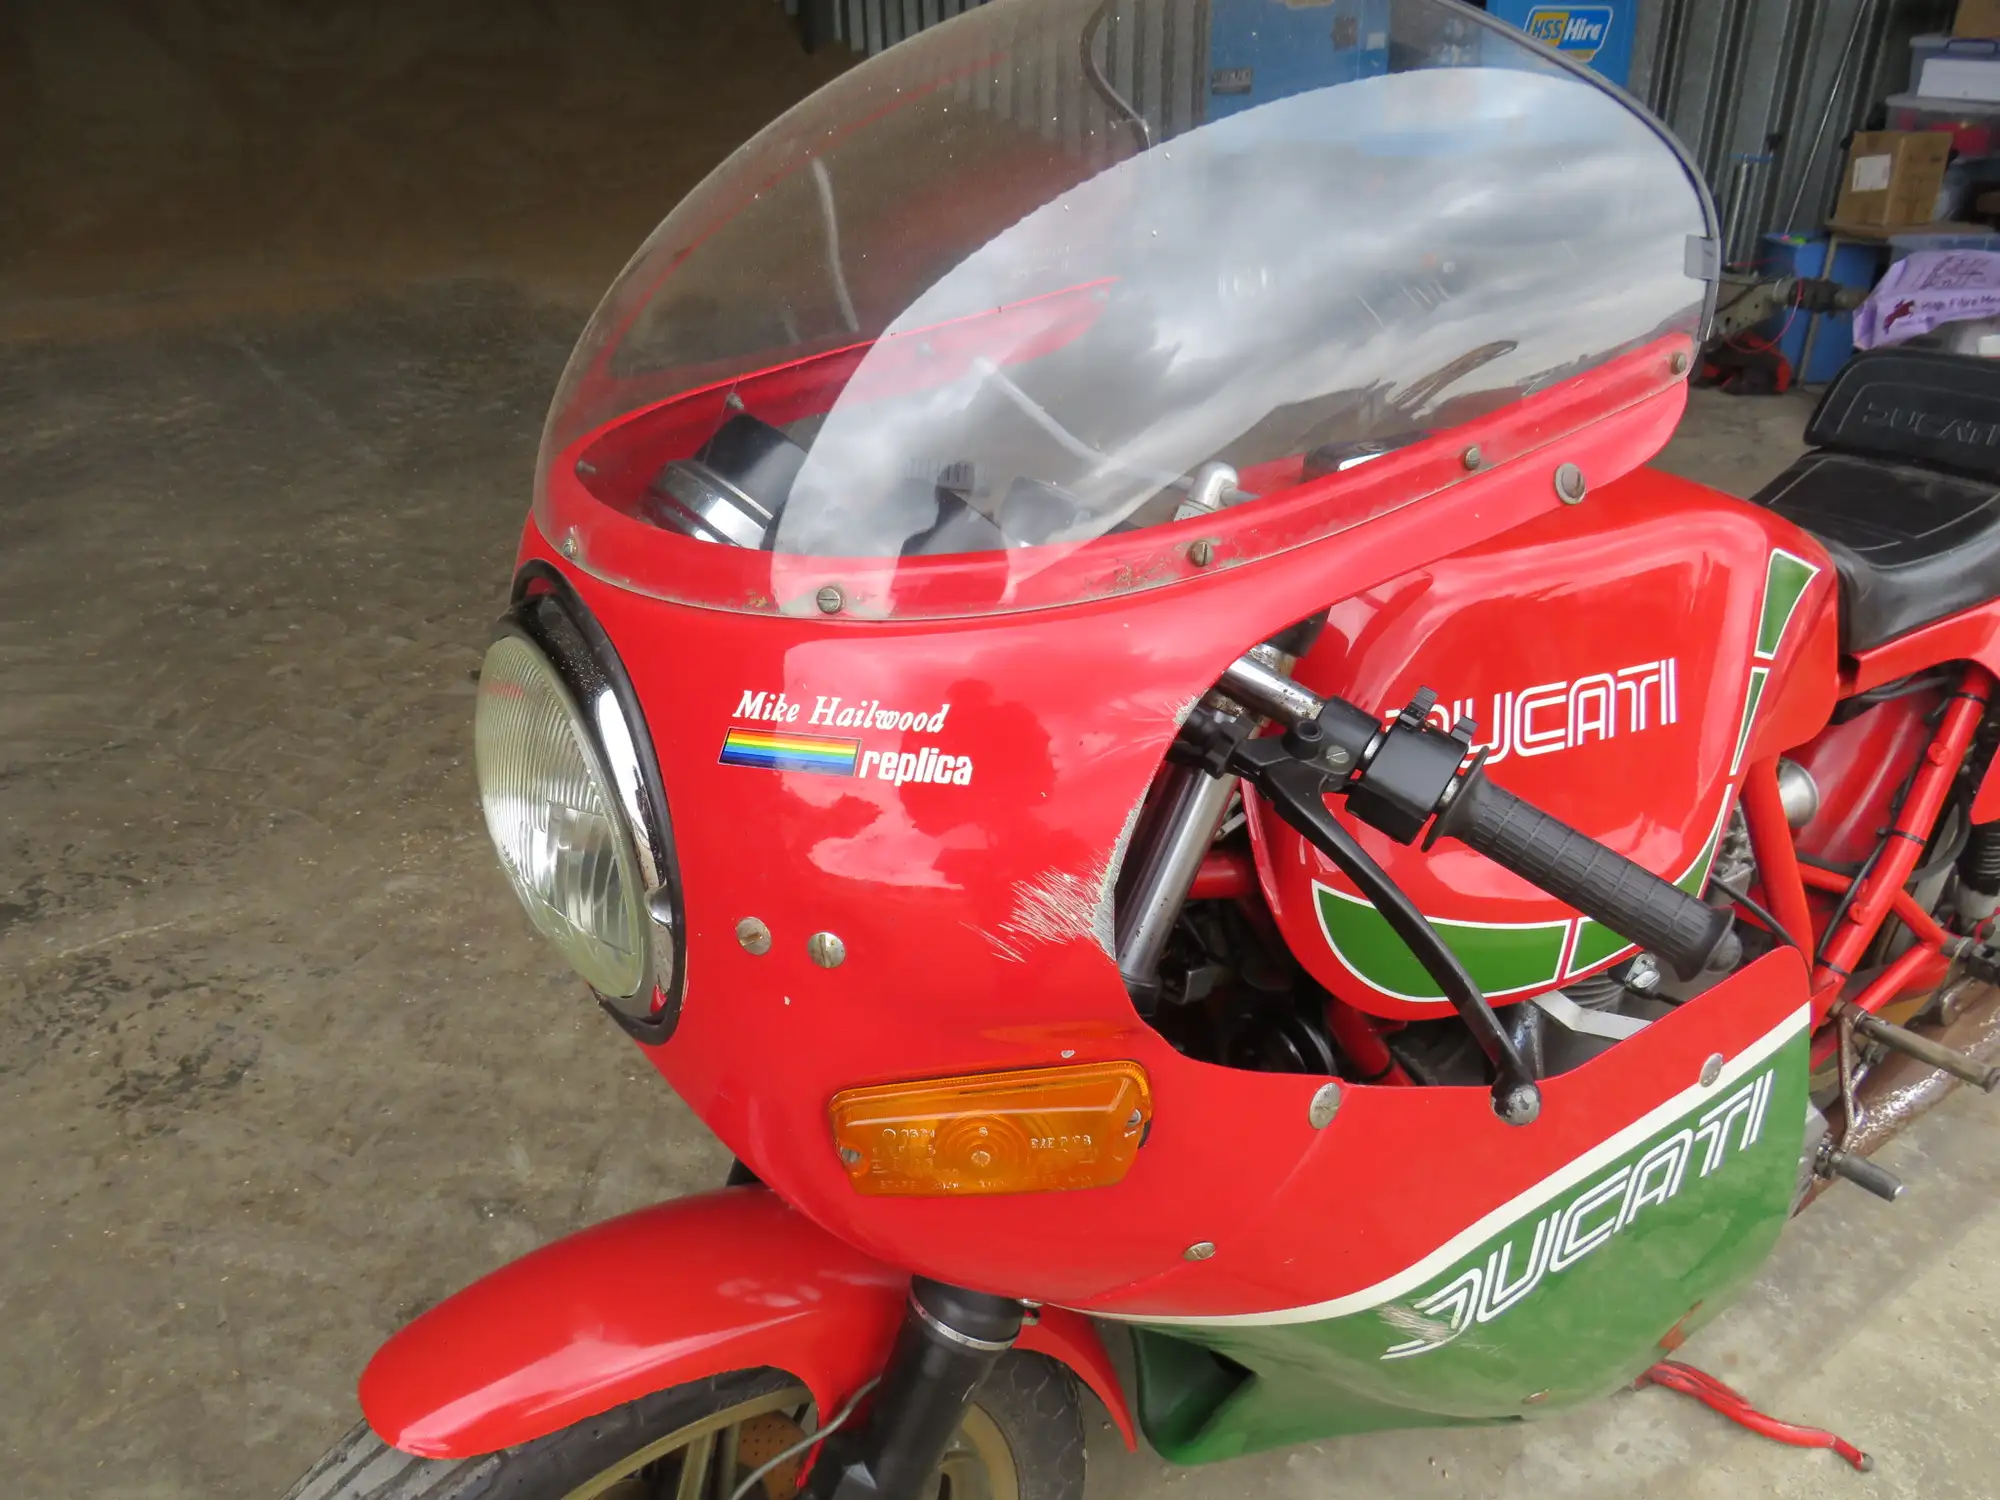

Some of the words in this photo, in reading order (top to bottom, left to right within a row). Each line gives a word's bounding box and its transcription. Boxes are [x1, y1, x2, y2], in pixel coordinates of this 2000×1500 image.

[1563, 17, 1603, 41] Hire
[732, 689, 800, 723] Mike
[808, 695, 951, 733] Hailwood
[858, 746, 974, 787] replica
[1379, 1068, 1776, 1361] DUCATI
